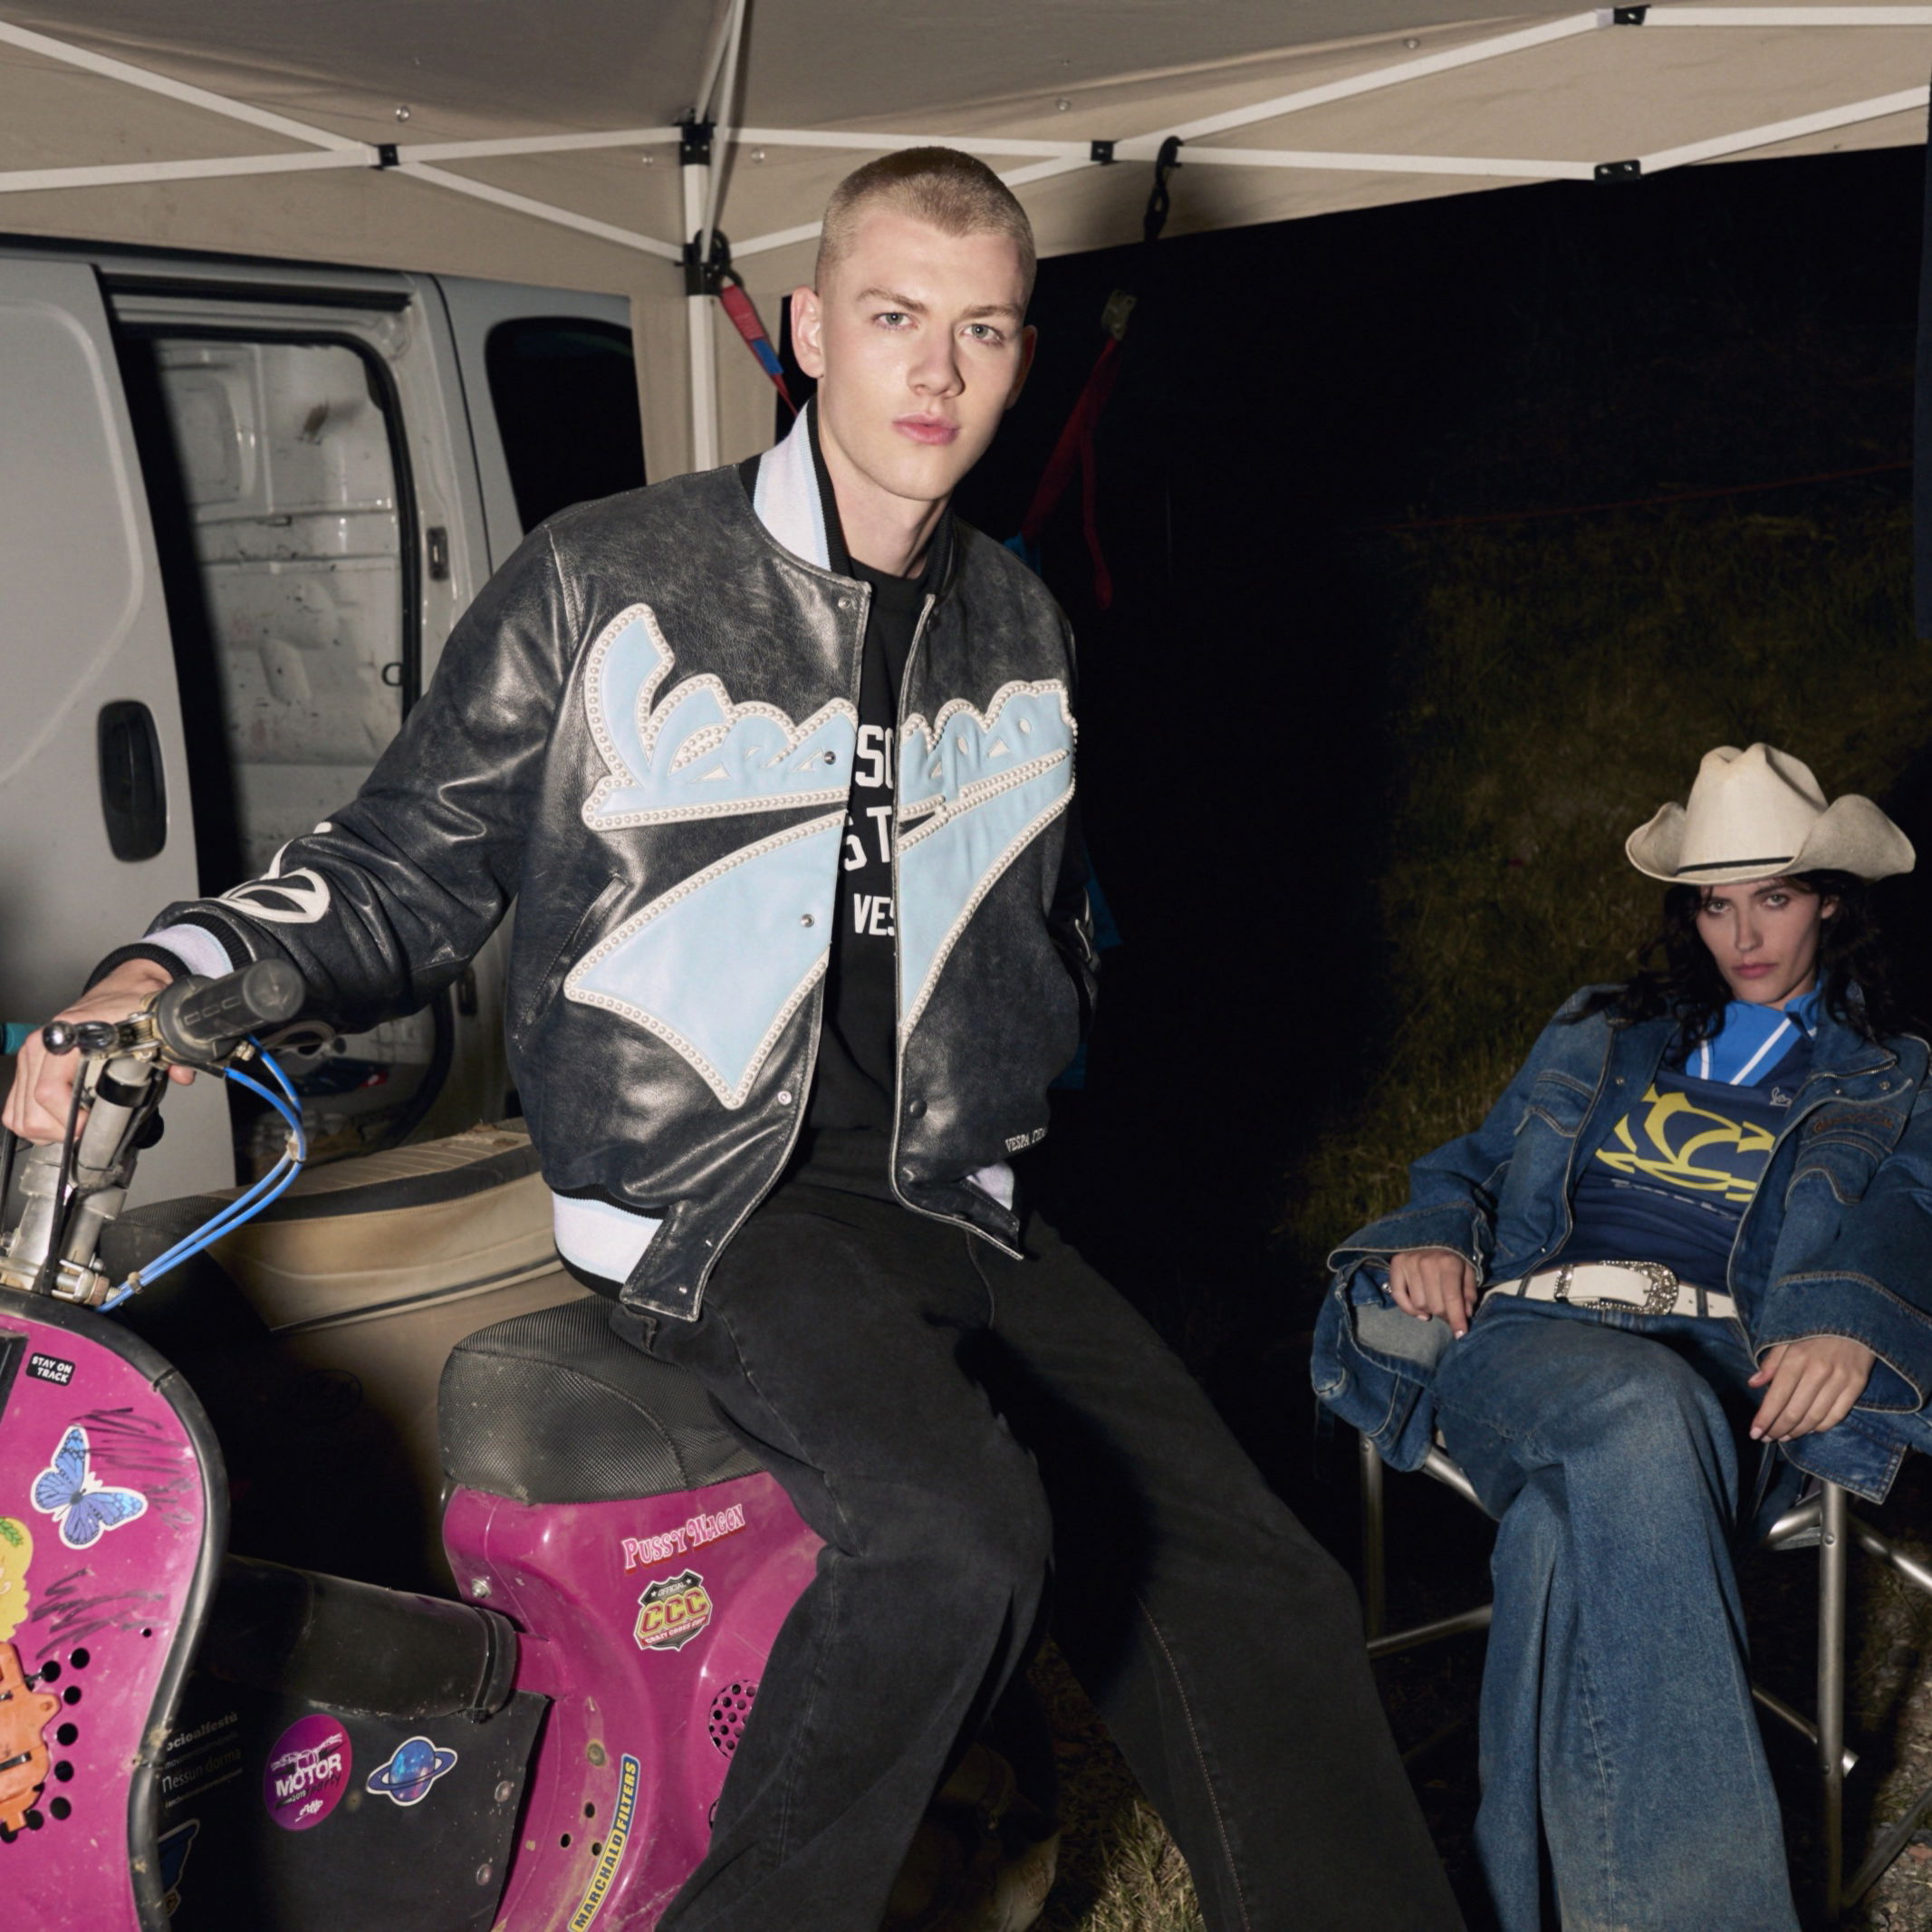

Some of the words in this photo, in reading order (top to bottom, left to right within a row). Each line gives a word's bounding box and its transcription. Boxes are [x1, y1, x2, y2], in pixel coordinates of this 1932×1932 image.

[32, 1355, 57, 1370] STAY
[56, 1362, 72, 1375] ON
[37, 1366, 70, 1384] TRACK
[639, 1589, 709, 1634] CCC
[274, 1752, 342, 1798] MOTOR
[292, 1789, 307, 1802] 2019
[573, 1832, 624, 1929] MARCHALD
[616, 1761, 638, 1832] FILTERS
